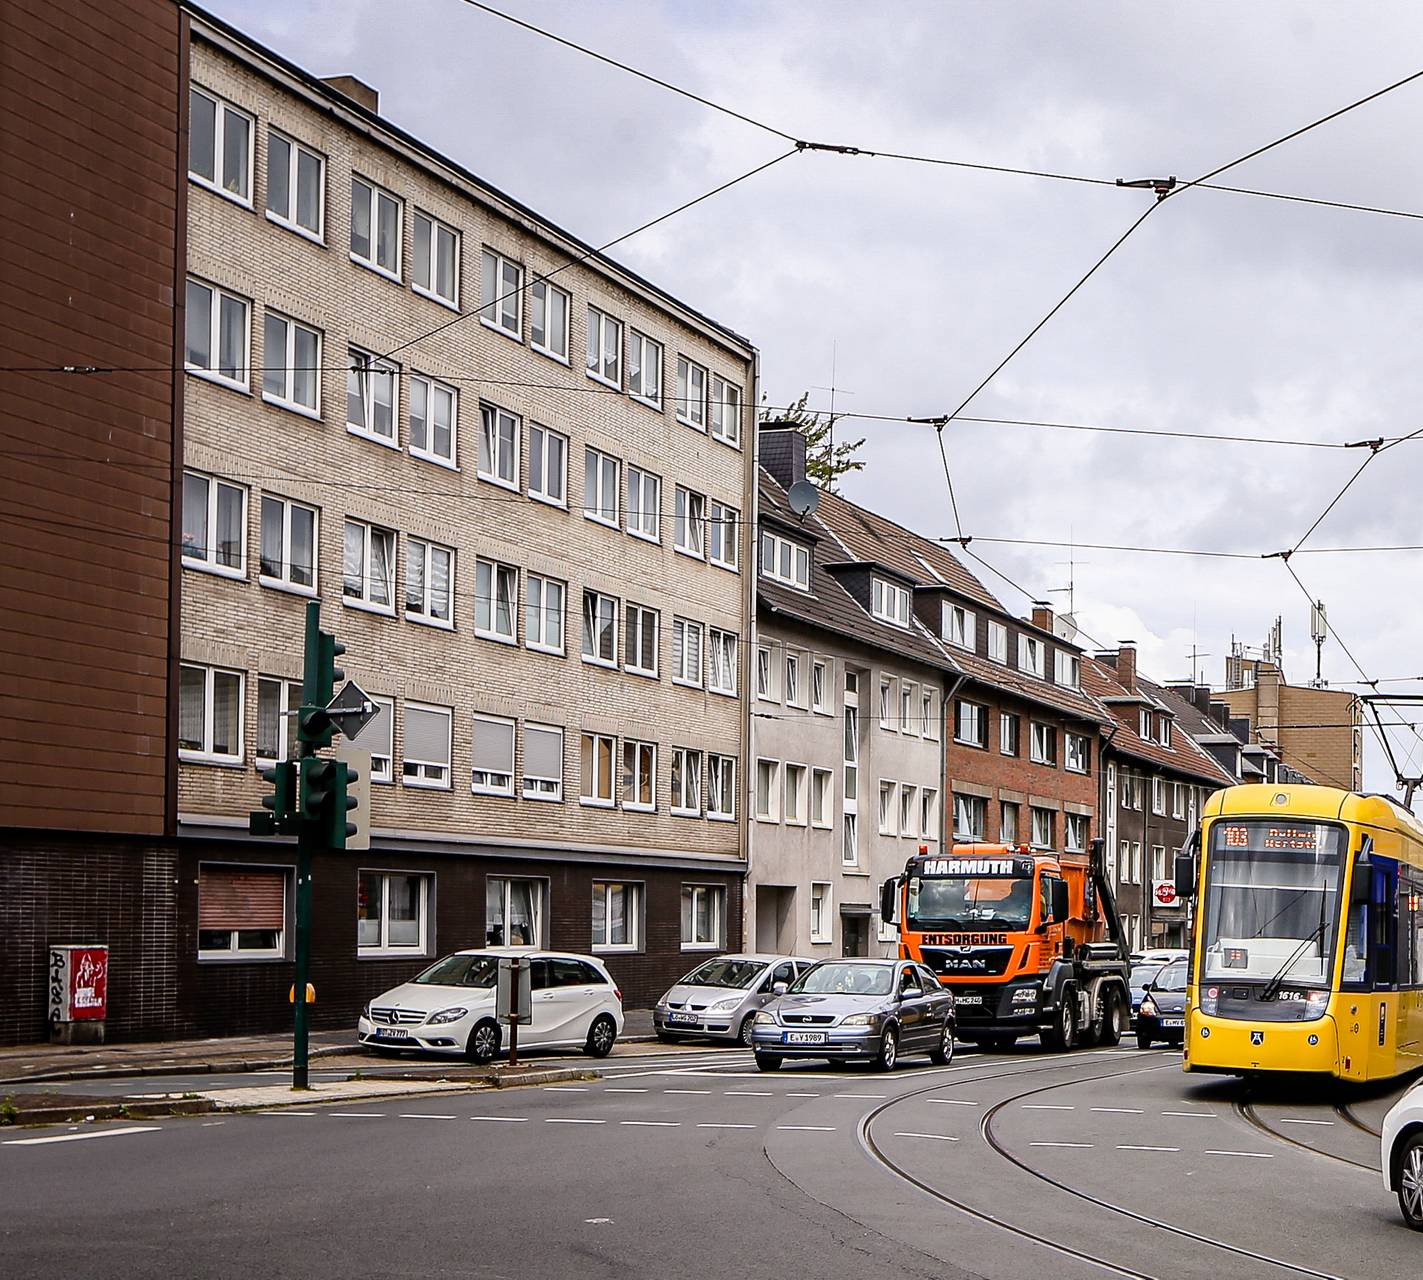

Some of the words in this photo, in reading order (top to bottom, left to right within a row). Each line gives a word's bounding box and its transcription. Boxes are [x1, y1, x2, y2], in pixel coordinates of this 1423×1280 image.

[1223, 826, 1248, 847] 103
[923, 860, 1014, 875] HARMUTH
[921, 933, 1008, 945] ENTSORGUNG
[945, 959, 986, 969] MAN
